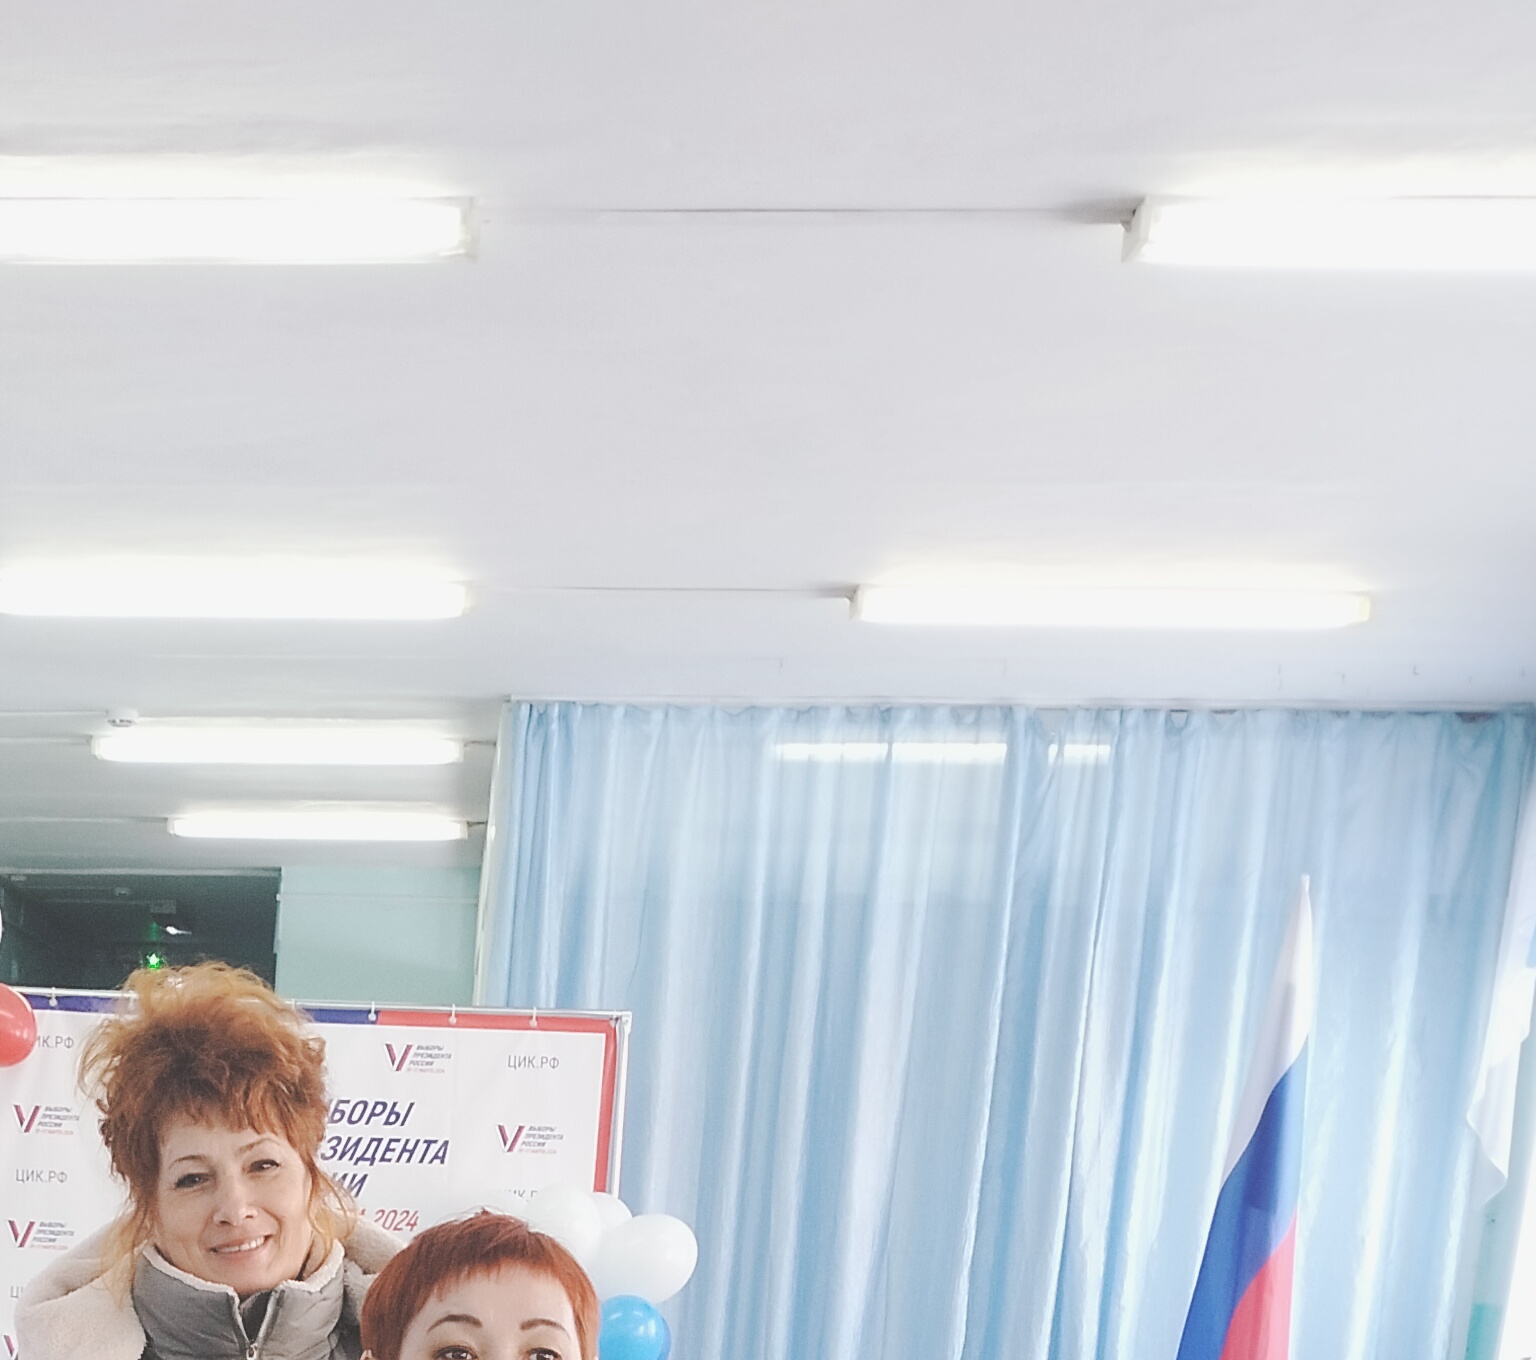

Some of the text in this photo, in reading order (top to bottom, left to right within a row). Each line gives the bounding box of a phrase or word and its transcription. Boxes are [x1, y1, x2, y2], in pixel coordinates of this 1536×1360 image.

[507, 1054, 560, 1070] ЦИК.РФ
[328, 1099, 415, 1127] БОРЫ
[320, 1135, 450, 1167] ЗИДЕНТА
[15, 1168, 68, 1184] ЦИК.РФ
